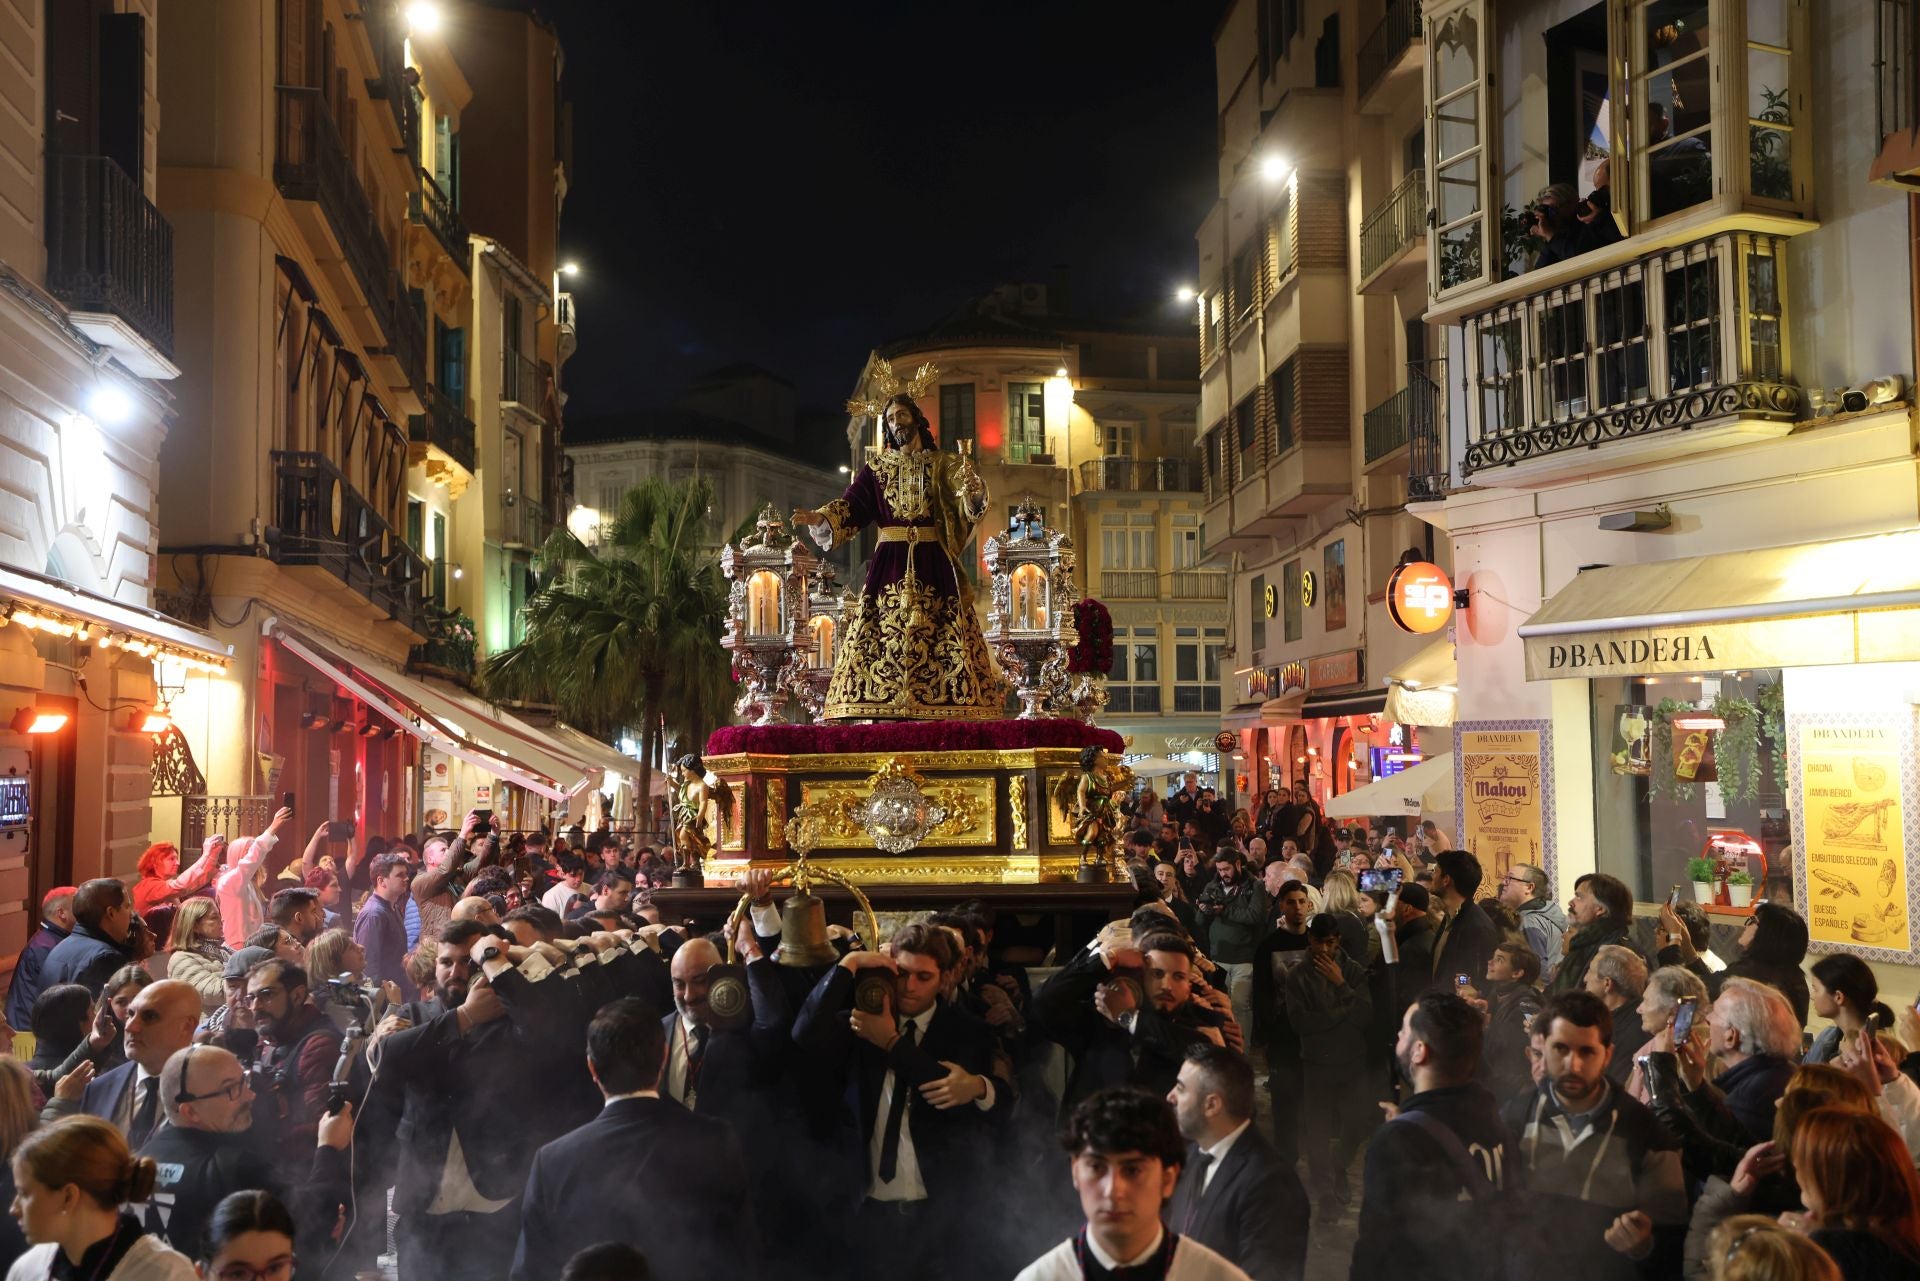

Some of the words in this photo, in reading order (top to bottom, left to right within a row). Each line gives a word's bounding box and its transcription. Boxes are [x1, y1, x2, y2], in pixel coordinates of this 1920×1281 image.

[1475, 781, 1527, 798] Mahou
[1811, 853, 1845, 864] EMBUTIDOS
[1845, 855, 1878, 867] SELECCIÓN
[1813, 904, 1837, 915] QUESOS
[1814, 917, 1849, 930] ESPAÑOLES
